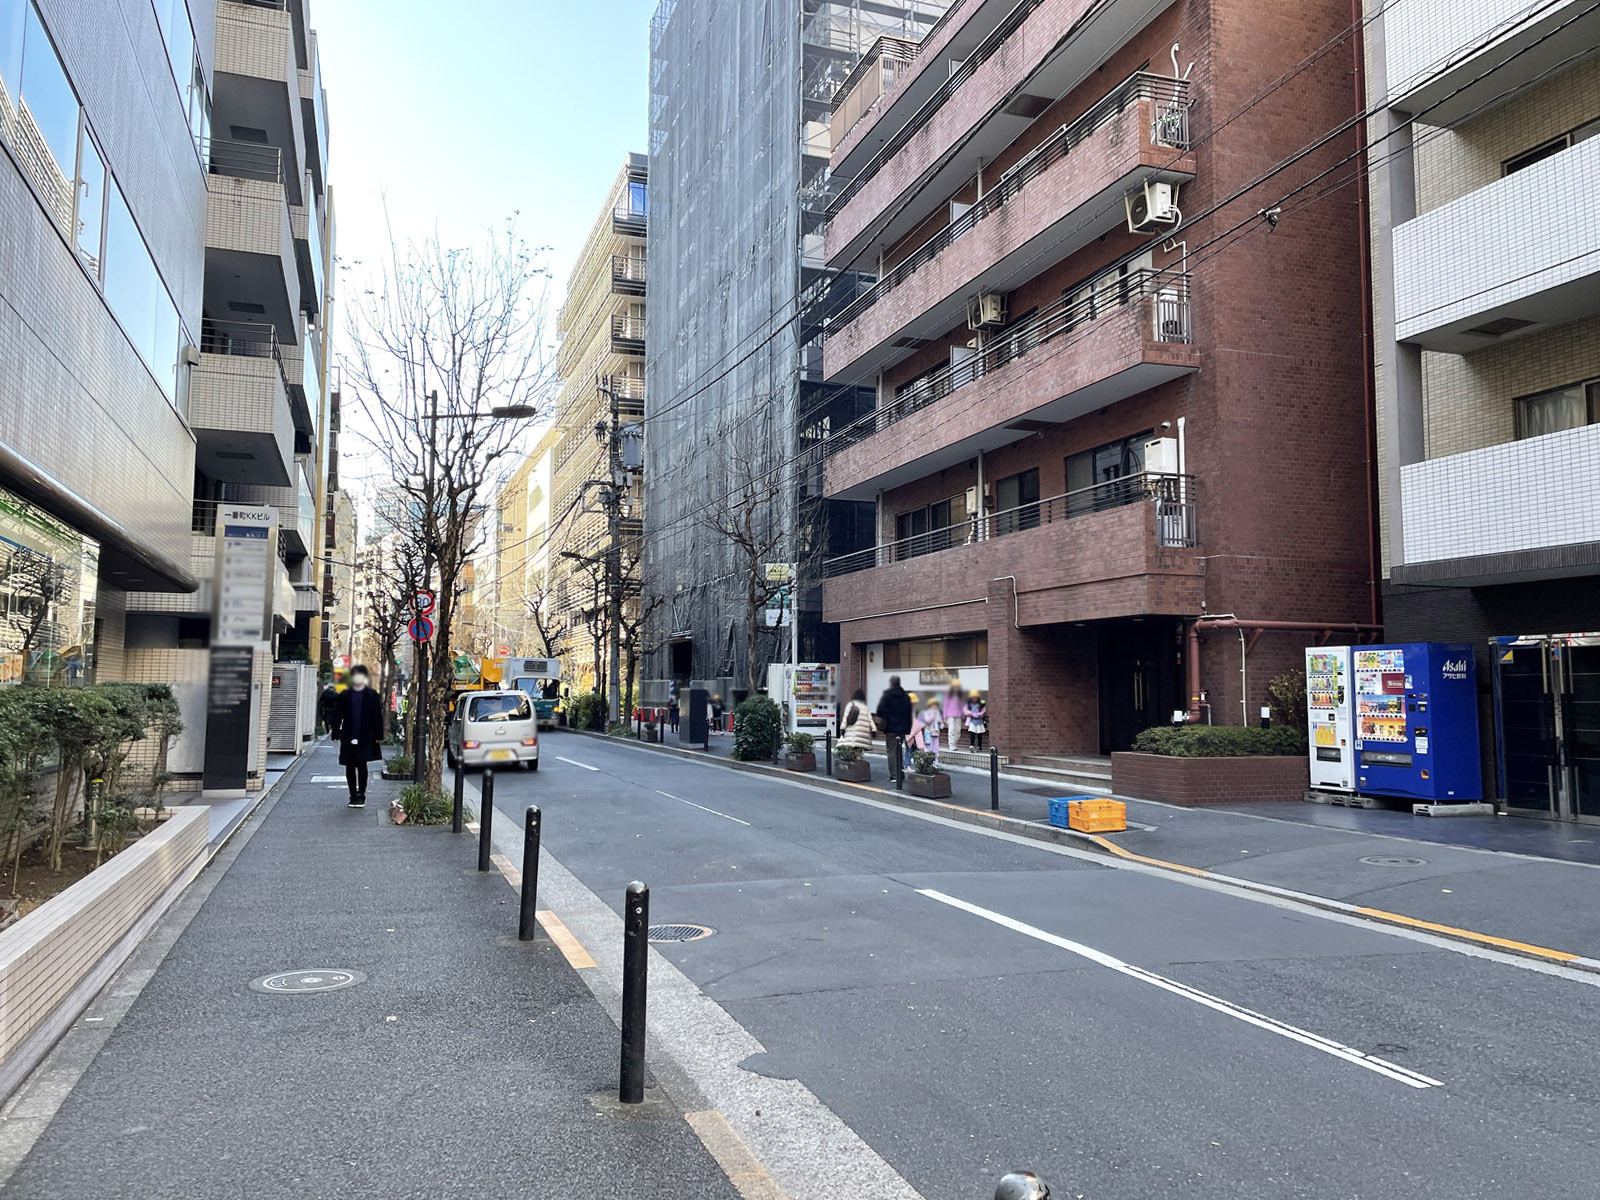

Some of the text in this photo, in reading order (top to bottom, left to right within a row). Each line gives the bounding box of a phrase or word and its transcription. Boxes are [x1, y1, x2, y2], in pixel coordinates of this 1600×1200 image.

[224, 511, 271, 521] 一番町KKビル
[1442, 660, 1466, 672] Asahi
